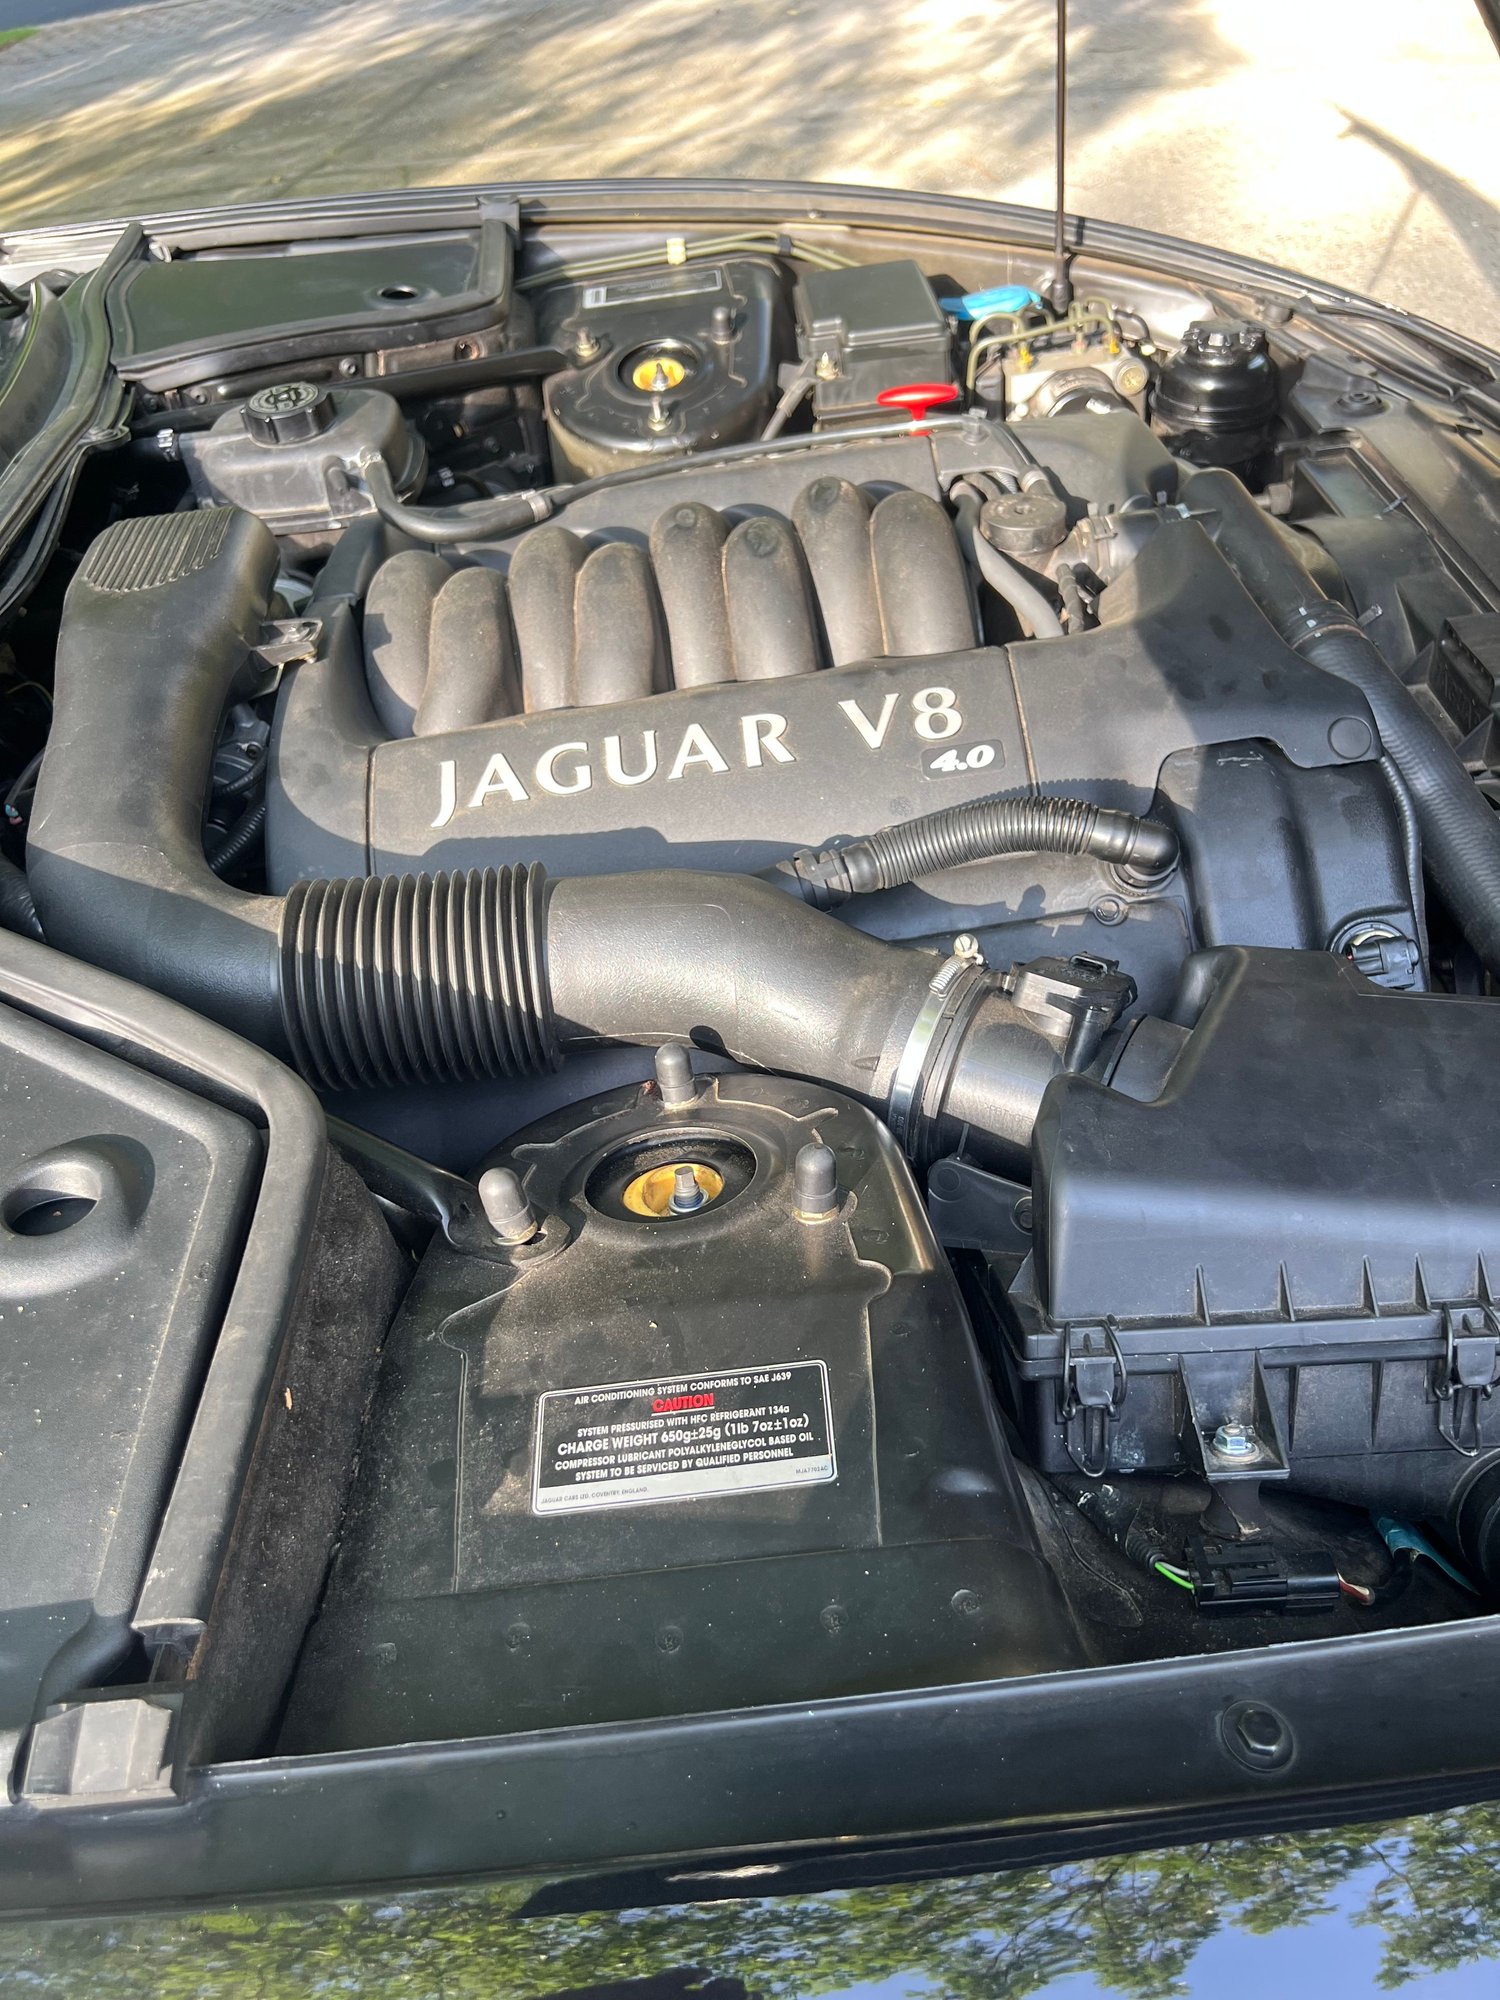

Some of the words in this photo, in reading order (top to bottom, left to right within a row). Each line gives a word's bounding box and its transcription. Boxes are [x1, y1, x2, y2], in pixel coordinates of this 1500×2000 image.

[430, 713, 798, 829] JAGUAR
[838, 686, 964, 751] V8
[929, 744, 995, 772] 4.0
[574, 1396, 590, 1405] AIR
[591, 1388, 656, 1403] CONDITIONING
[657, 1384, 688, 1395] SYSTEM
[690, 1377, 739, 1391] CONFORMS
[741, 1376, 752, 1385] TO
[753, 1374, 770, 1384] SAE
[771, 1371, 792, 1382] J639
[652, 1393, 715, 1412] CAUTION
[557, 1438, 610, 1456] CHARGE
[611, 1432, 660, 1449] WEIGHT
[661, 1425, 722, 1444] 650g±25g
[724, 1420, 750, 1437] (1lb
[752, 1413, 810, 1433] 7oz±1oz)
[577, 1425, 609, 1438] SYSTEM
[610, 1419, 665, 1434] PRESSURISED
[666, 1416, 688, 1427] WITH
[690, 1413, 708, 1425] HFC
[710, 1406, 767, 1422] REFRIGERANT
[768, 1405, 790, 1415] 134a
[554, 1455, 616, 1471] COMPRESSOR
[617, 1449, 667, 1464] LUBRICANT
[668, 1437, 767, 1457] POLYALKYLENEGLYCOL
[768, 1434, 797, 1446] BASED
[798, 1431, 814, 1442] OIL
[575, 1469, 608, 1481] SYSTEM
[610, 1467, 622, 1477] TO
[624, 1465, 635, 1475] BE
[637, 1461, 680, 1474] SERVICED
[681, 1459, 693, 1469] BY
[695, 1454, 741, 1468] QUALIFIED
[743, 1447, 794, 1463] PERSONNEL
[541, 1496, 563, 1505] JAGUAR
[564, 1494, 579, 1502] CARS
